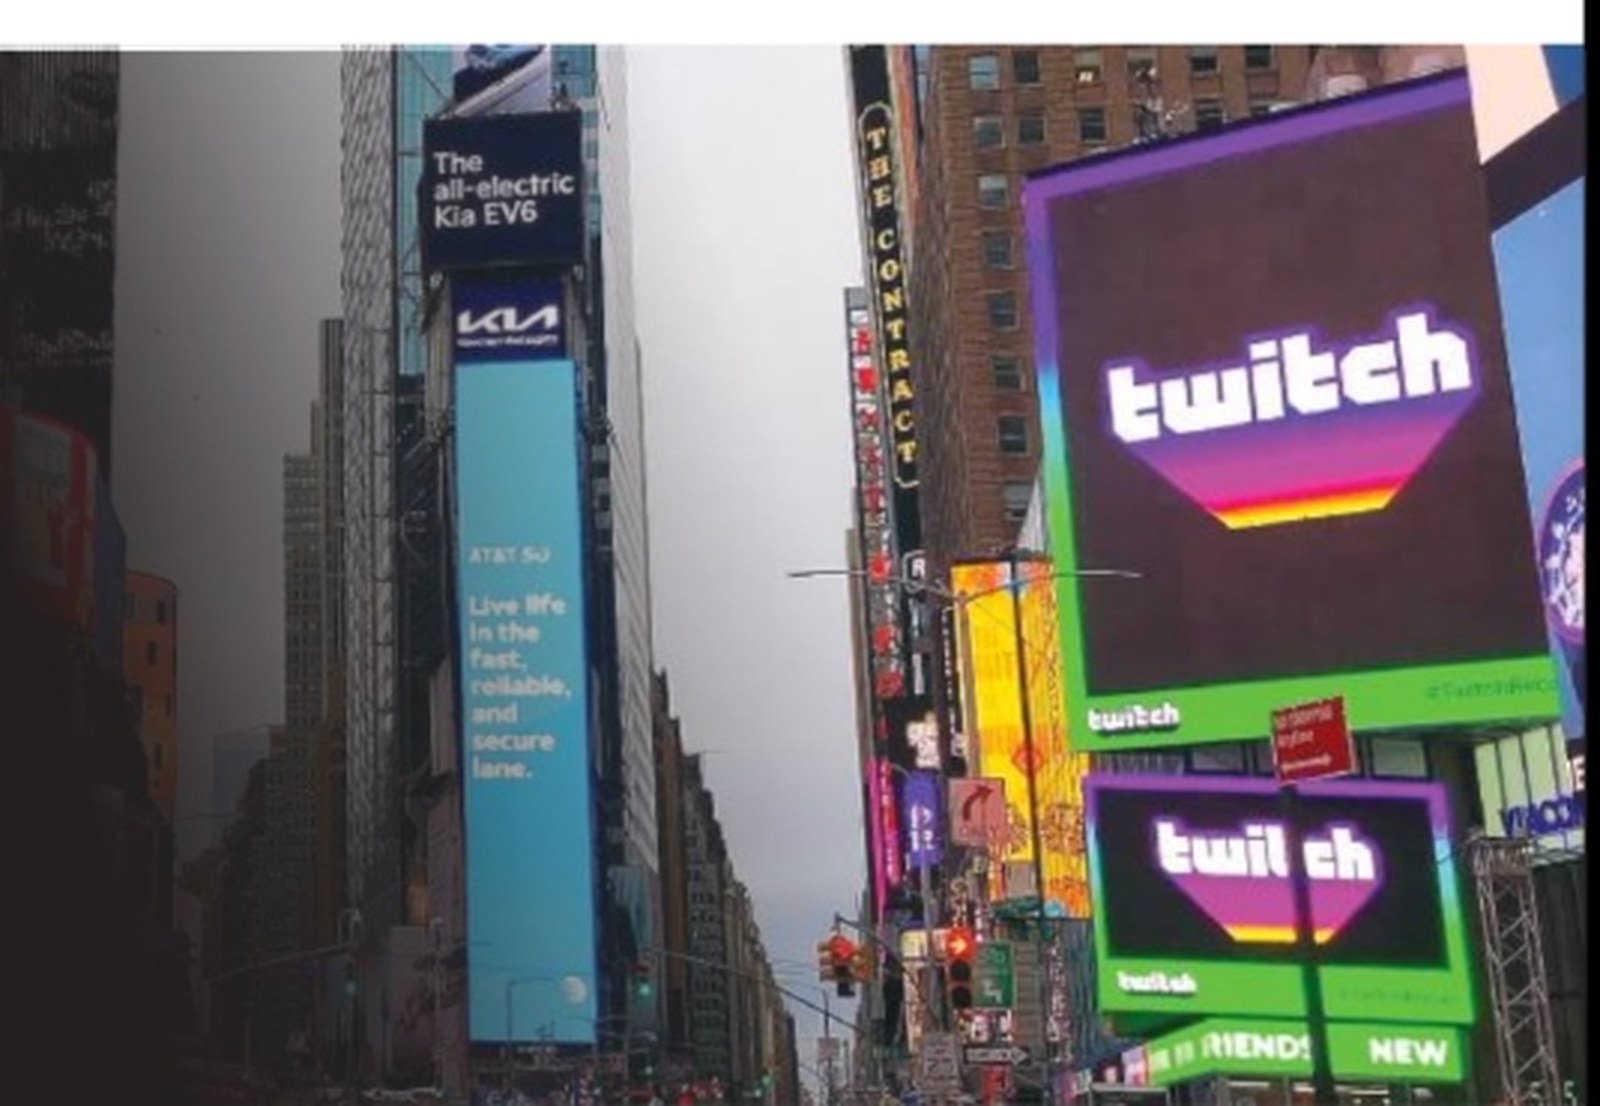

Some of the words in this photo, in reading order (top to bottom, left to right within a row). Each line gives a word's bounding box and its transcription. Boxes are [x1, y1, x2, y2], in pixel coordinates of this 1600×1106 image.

[434, 152, 483, 174] The
[866, 127, 892, 207] THE
[434, 172, 574, 201] all-electric
[434, 205, 476, 229] Kia
[484, 200, 538, 225] EV6
[877, 229, 917, 463] CONTRACT
[1107, 312, 1472, 443] twitch
[469, 596, 519, 617] Live
[499, 621, 540, 643] the
[472, 703, 518, 724] and
[1088, 702, 1180, 732] twitch
[473, 732, 556, 752] secure
[473, 757, 533, 778] lane.
[1368, 1037, 1447, 1066] NEW
